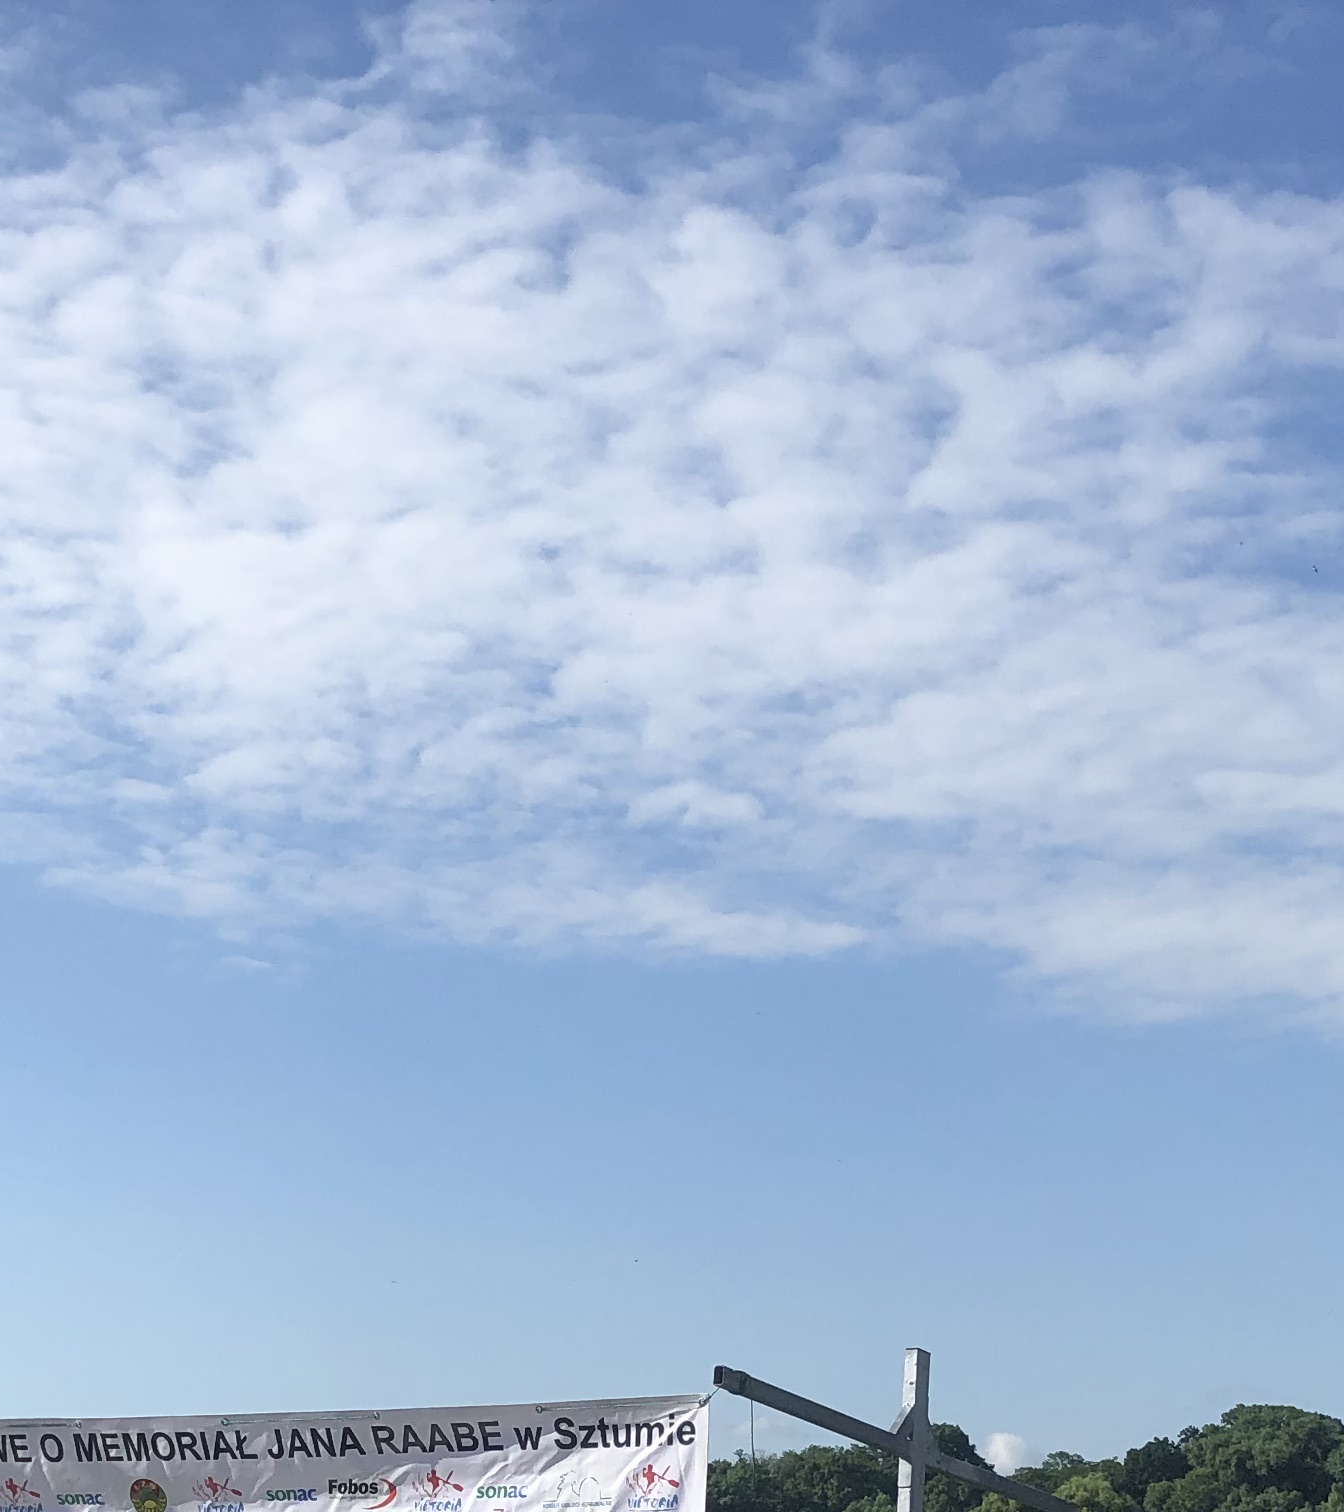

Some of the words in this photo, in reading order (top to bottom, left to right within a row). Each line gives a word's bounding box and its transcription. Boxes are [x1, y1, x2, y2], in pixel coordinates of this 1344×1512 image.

[40, 1433, 63, 1462] O
[73, 1430, 258, 1462] MEMORIAŁ
[268, 1426, 366, 1459] JANA
[371, 1420, 504, 1454] RAABE
[513, 1427, 542, 1450] w
[554, 1414, 696, 1450] Sztumie
[328, 1479, 378, 1495] Fobos
[477, 1485, 528, 1499] sonac
[57, 1492, 105, 1505] sonac
[266, 1488, 317, 1501] sonac
